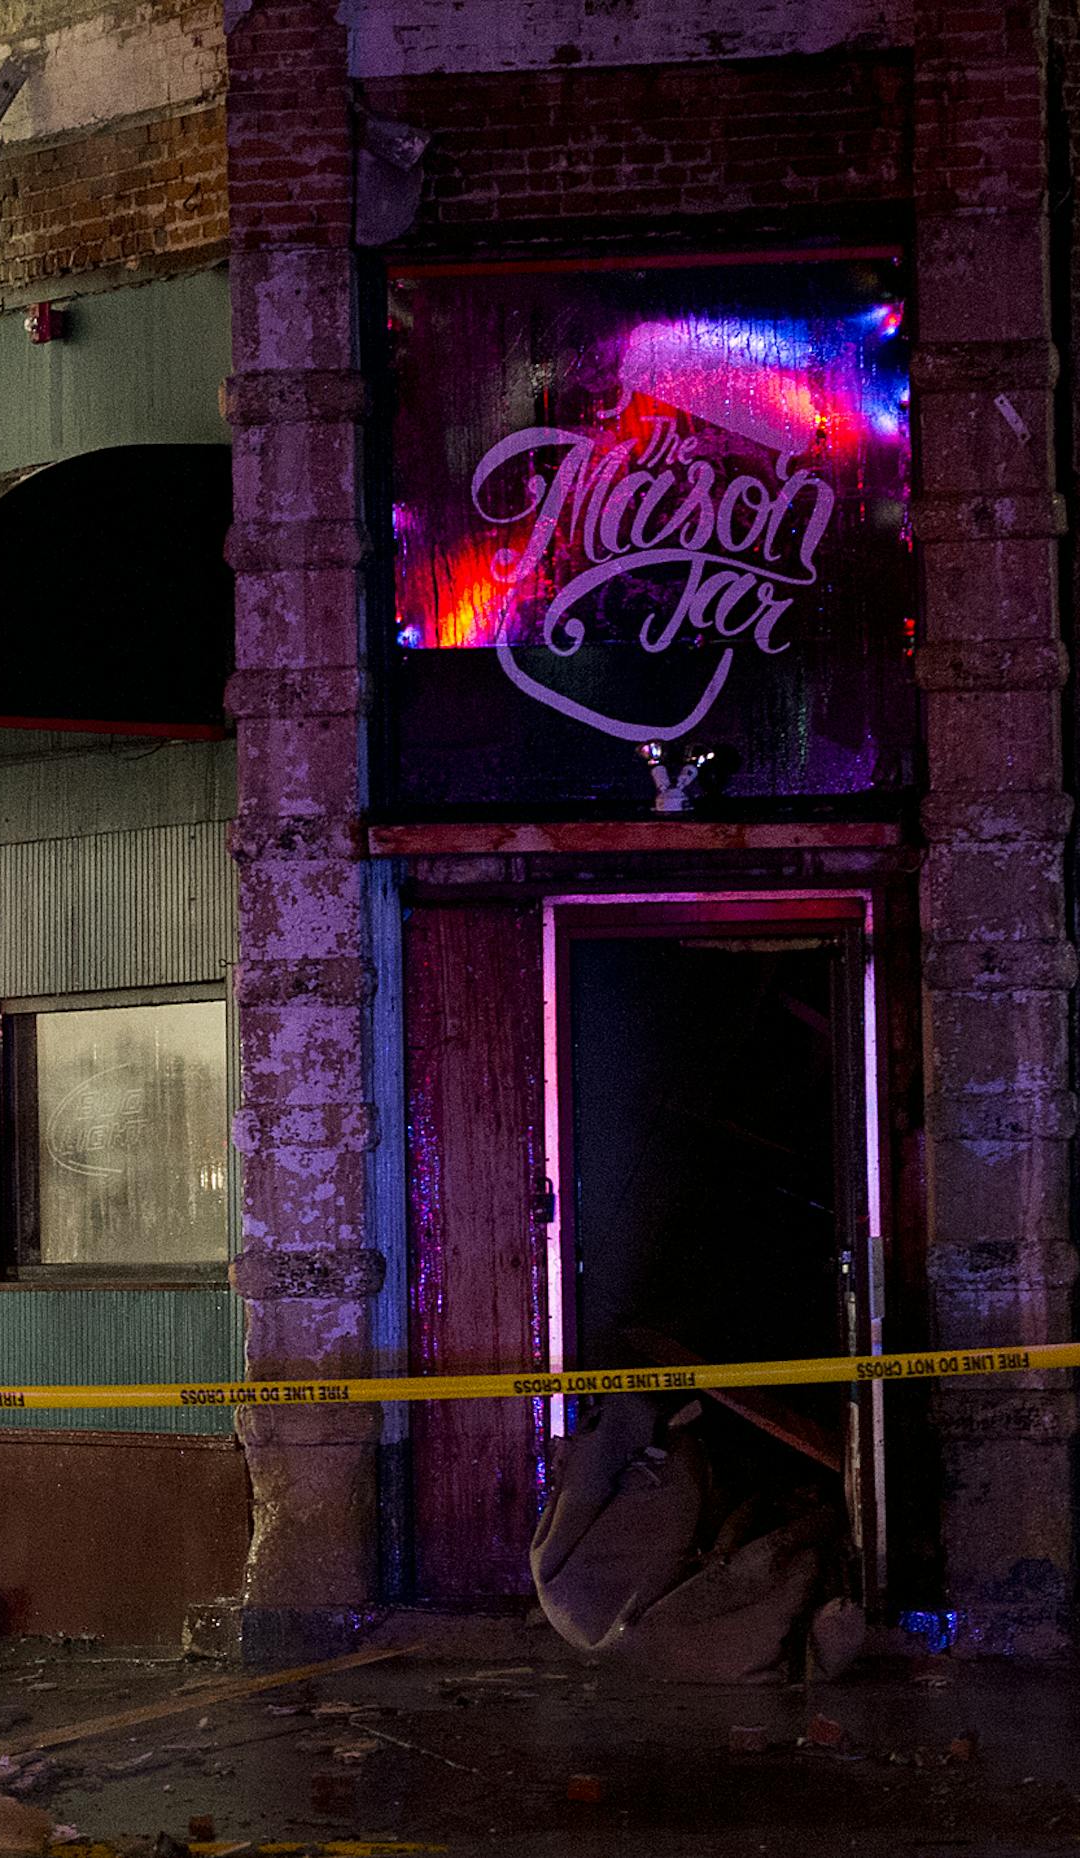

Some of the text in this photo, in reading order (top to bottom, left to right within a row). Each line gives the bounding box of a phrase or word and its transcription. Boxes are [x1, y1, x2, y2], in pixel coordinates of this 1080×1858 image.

[636, 415, 699, 468] The
[471, 427, 835, 585] Mason
[543, 549, 794, 656] Jar
[513, 1372, 696, 1394] FIRE LINE DO NOT CROSS
[856, 1352, 1030, 1378] FIRE LINE DO NOT CROSS
[180, 1385, 349, 1405] FIRE LINE DO NOT CROSS
